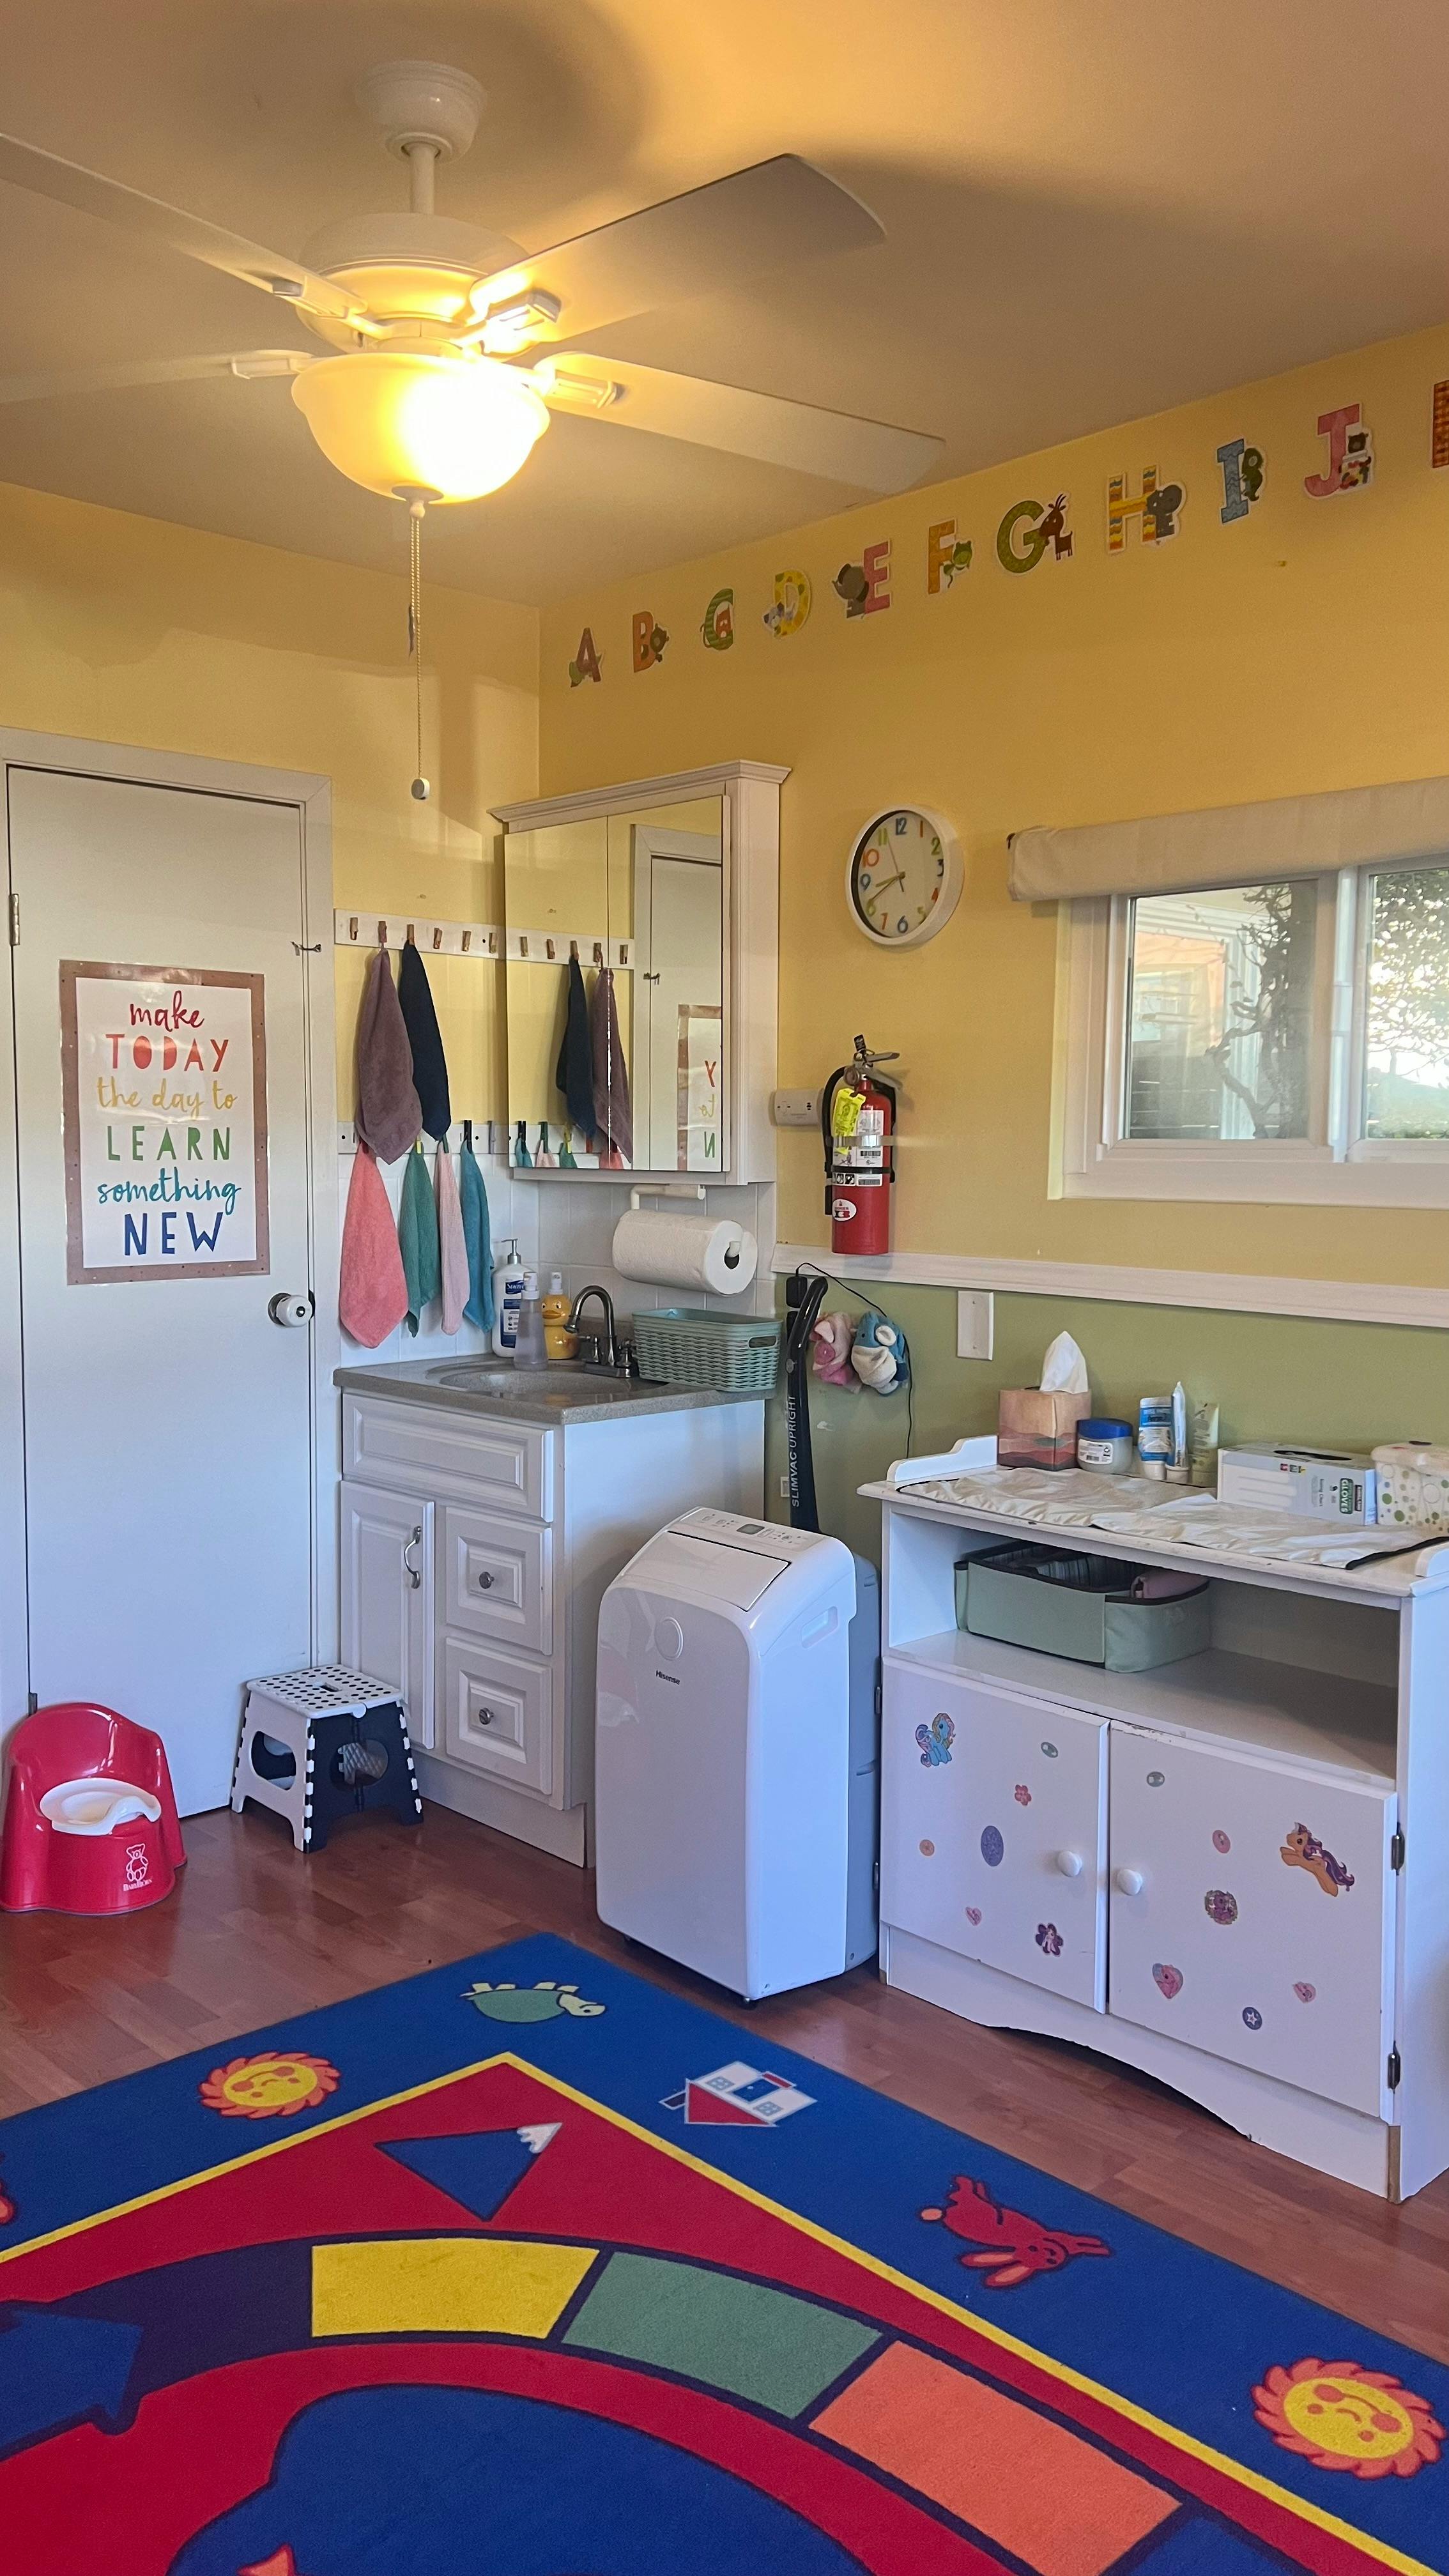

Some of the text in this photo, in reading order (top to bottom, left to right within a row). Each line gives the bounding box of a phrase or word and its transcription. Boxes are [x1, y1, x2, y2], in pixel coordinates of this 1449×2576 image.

[576, 627, 602, 682] A
[632, 611, 656, 673] B
[773, 569, 810, 637] D
[864, 541, 891, 614] E
[928, 519, 955, 594] F
[997, 500, 1046, 573] G
[1108, 465, 1157, 550] H
[1217, 438, 1249, 523] I
[1305, 403, 1360, 497] J
[895, 817, 908, 836] 12
[919, 820, 924, 838] 1
[878, 828, 887, 846] 11
[931, 838, 940, 855] 2
[862, 848, 880, 868] 10
[860, 873, 871, 892] 9
[880, 912, 889, 930] 7
[897, 915, 908, 933] 6
[130, 990, 205, 1032] make
[105, 1034, 229, 1072] TODAY
[96, 1076, 238, 1119] the day to
[107, 1125, 230, 1161] LEARN
[97, 1167, 241, 1215] something
[124, 1211, 223, 1256] NEW
[787, 1396, 800, 1507] SLIMVAC UPRIGHT
[656, 1669, 680, 1685] Hisense
